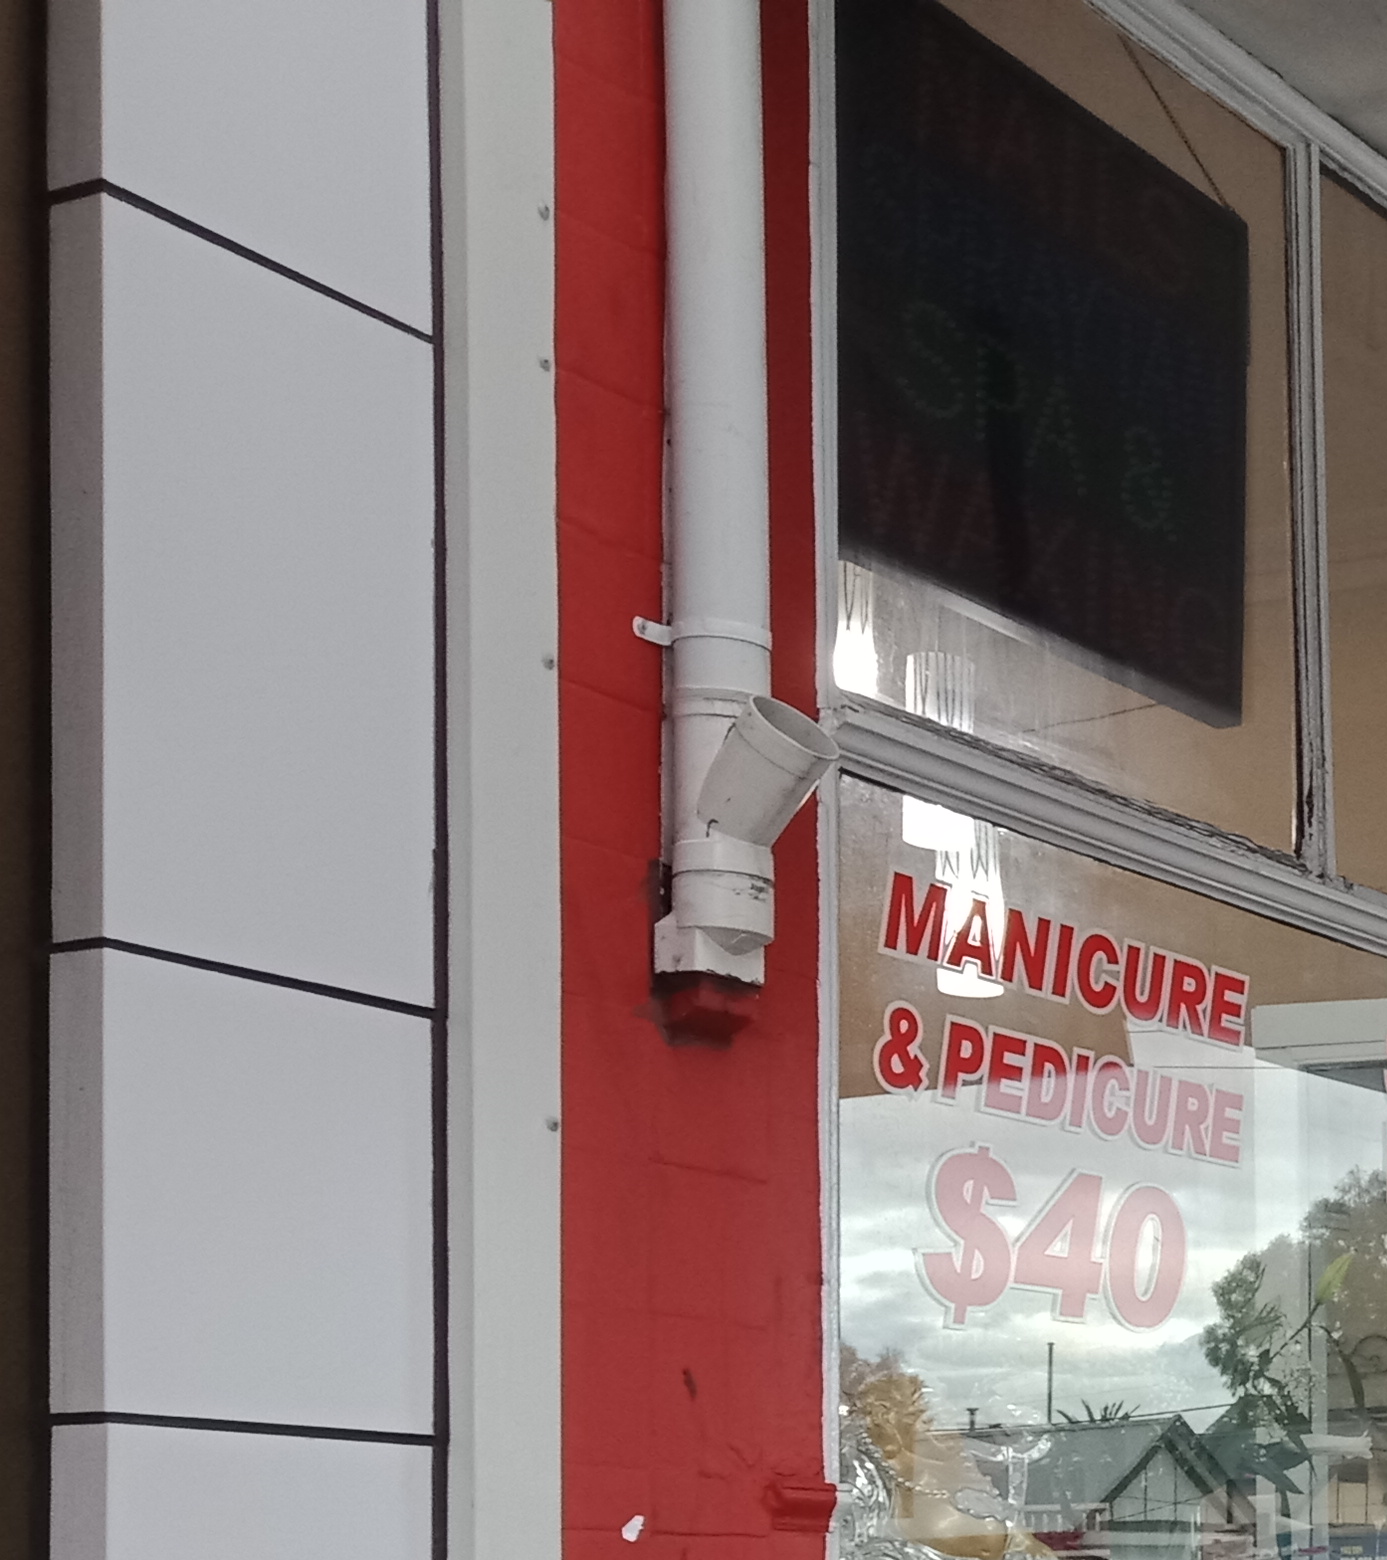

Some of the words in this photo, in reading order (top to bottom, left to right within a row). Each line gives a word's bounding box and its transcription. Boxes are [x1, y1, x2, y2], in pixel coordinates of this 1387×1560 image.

[879, 870, 1250, 1051] MANICURE
[874, 1001, 928, 1096] &
[935, 1014, 1247, 1168] PEDICURE
[915, 1145, 1188, 1332] $40
